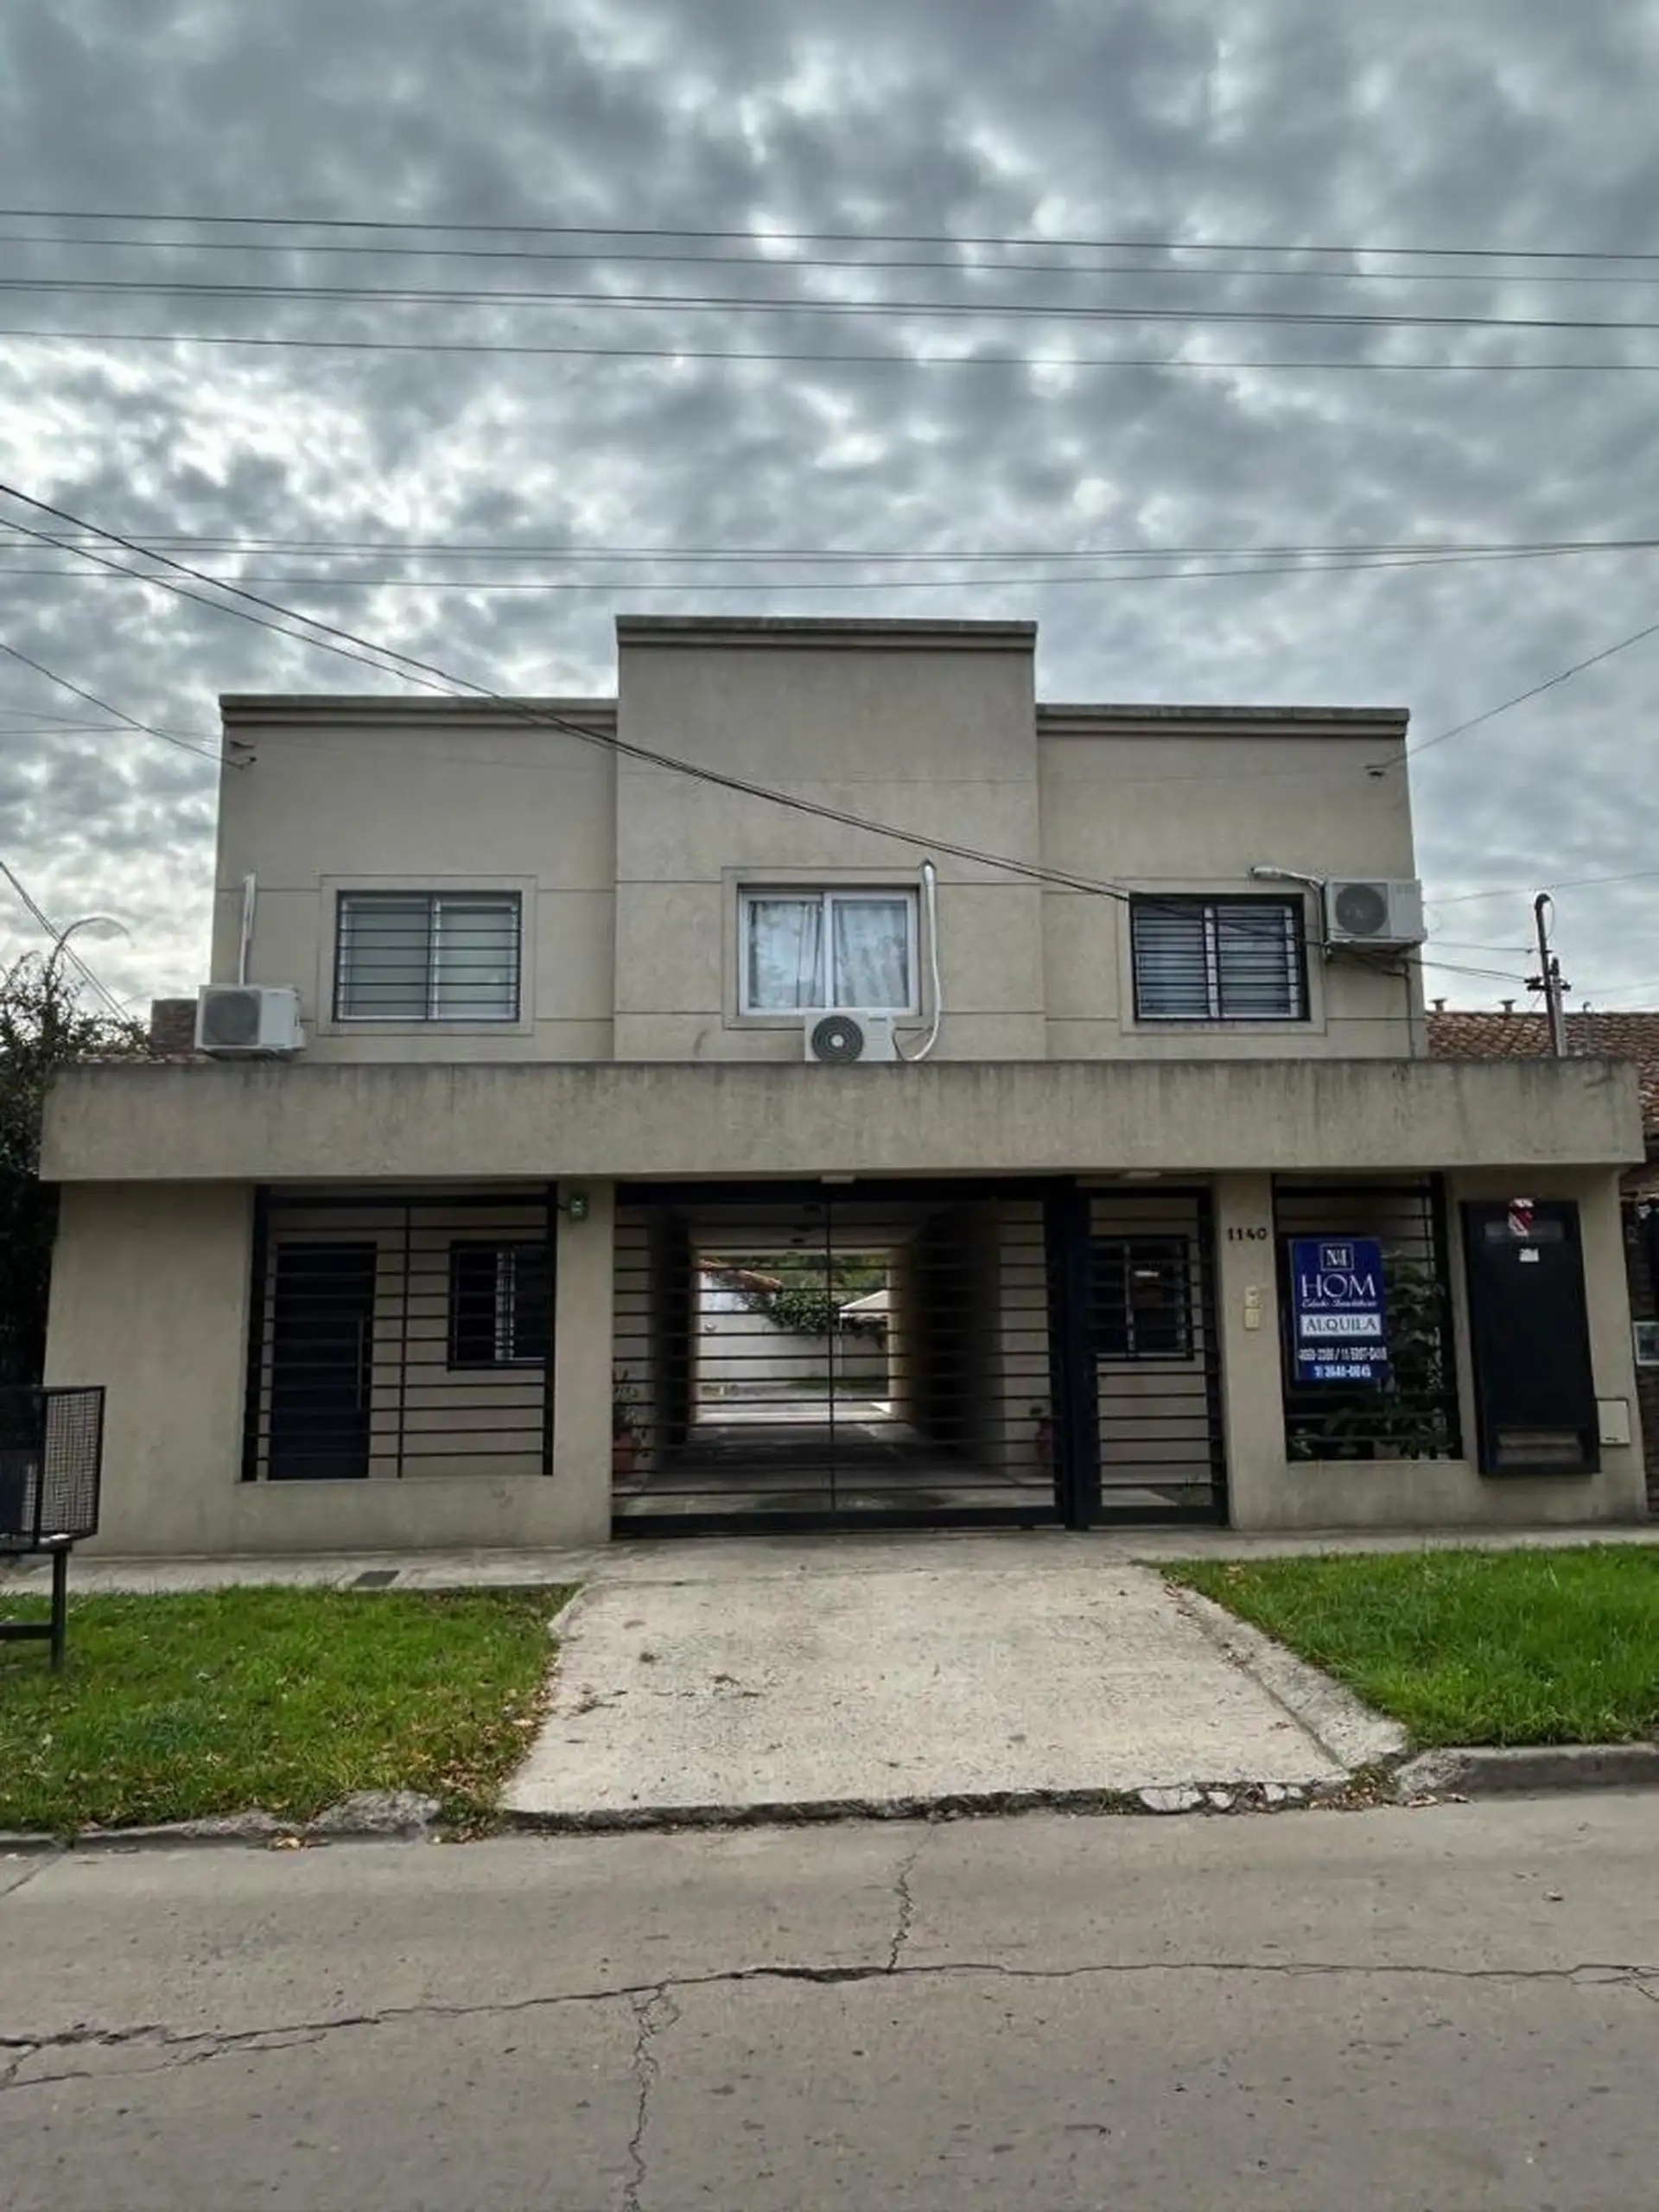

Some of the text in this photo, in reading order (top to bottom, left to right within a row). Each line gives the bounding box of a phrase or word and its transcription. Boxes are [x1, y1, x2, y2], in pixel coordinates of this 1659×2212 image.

[1228, 1227, 1268, 1242] 1140
[1301, 1274, 1376, 1298] HOM
[1306, 1318, 1377, 1332] ALQUILA
